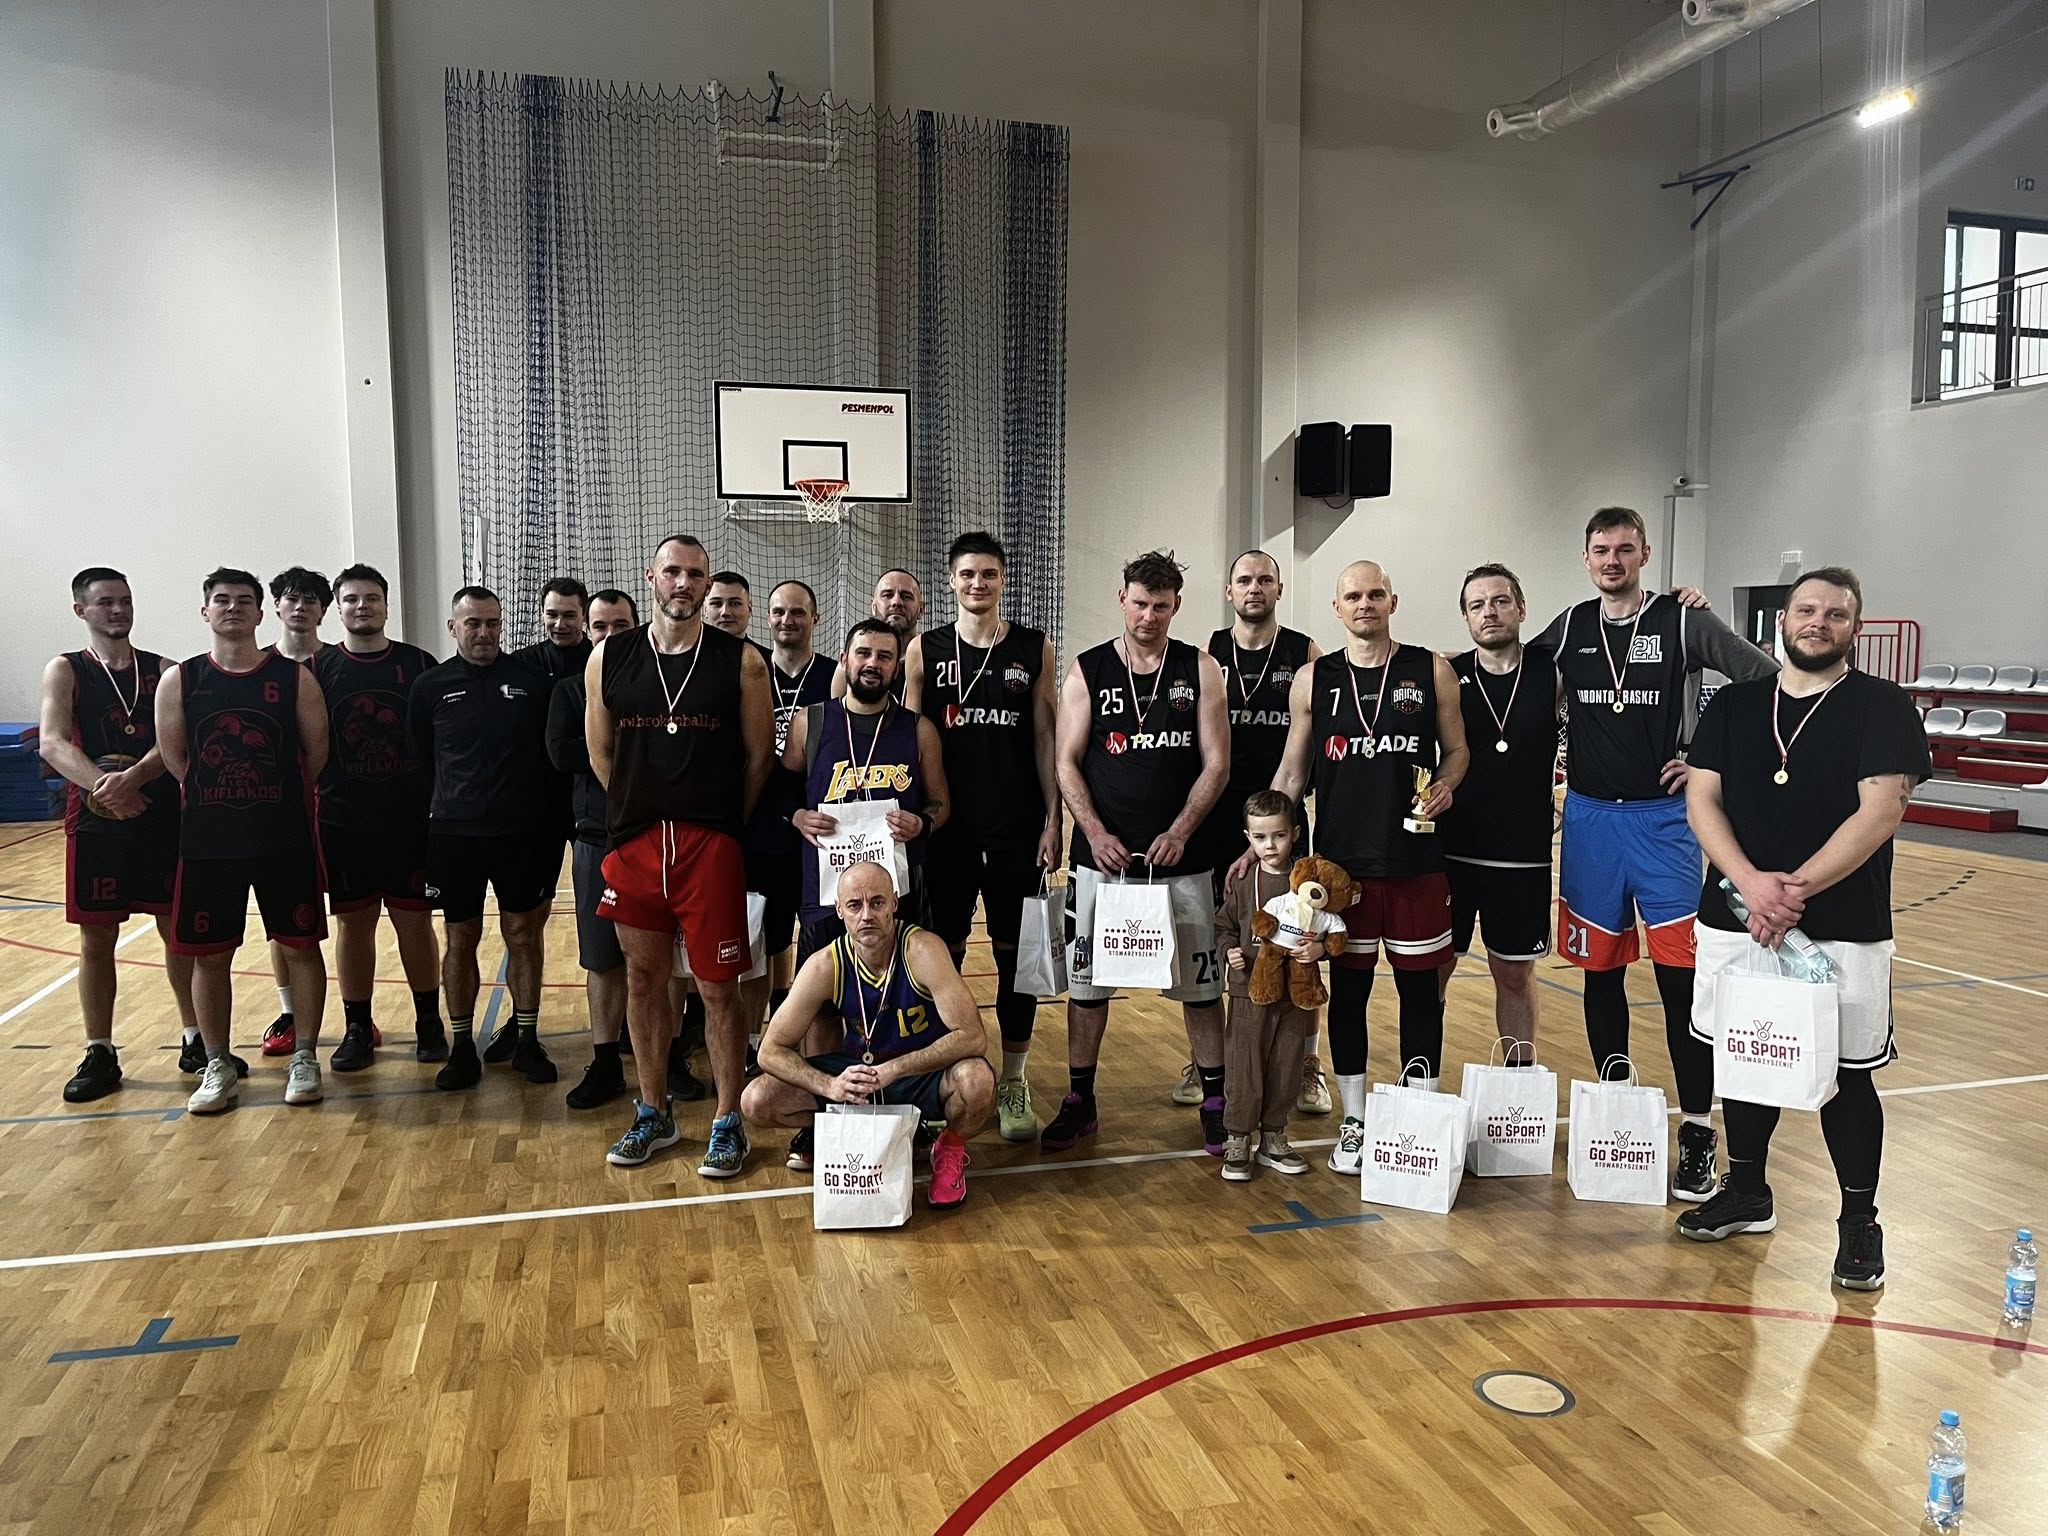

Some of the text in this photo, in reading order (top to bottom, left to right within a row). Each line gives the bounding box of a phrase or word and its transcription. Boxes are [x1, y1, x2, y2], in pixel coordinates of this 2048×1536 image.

[841, 403, 895, 414] PESMENPOL
[1629, 635, 1662, 663] 21
[936, 660, 958, 687] 20
[1004, 668, 1030, 685] BRICKS
[264, 680, 280, 704] 6
[1099, 687, 1124, 715] 25
[1169, 686, 1194, 701] BRICKS
[1329, 687, 1340, 716] 7
[1393, 688, 1423, 704] BRICKS
[1622, 690, 1660, 705] BASKET
[963, 707, 1020, 727] TRADE
[1230, 709, 1290, 726] TRADE
[1130, 730, 1192, 749] TRADE
[1349, 735, 1419, 755] TRADE
[92, 877, 118, 900] 12
[194, 911, 210, 933] 6
[1567, 923, 1589, 957] 21
[1192, 949, 1221, 985] 25
[896, 1004, 929, 1038] 12
